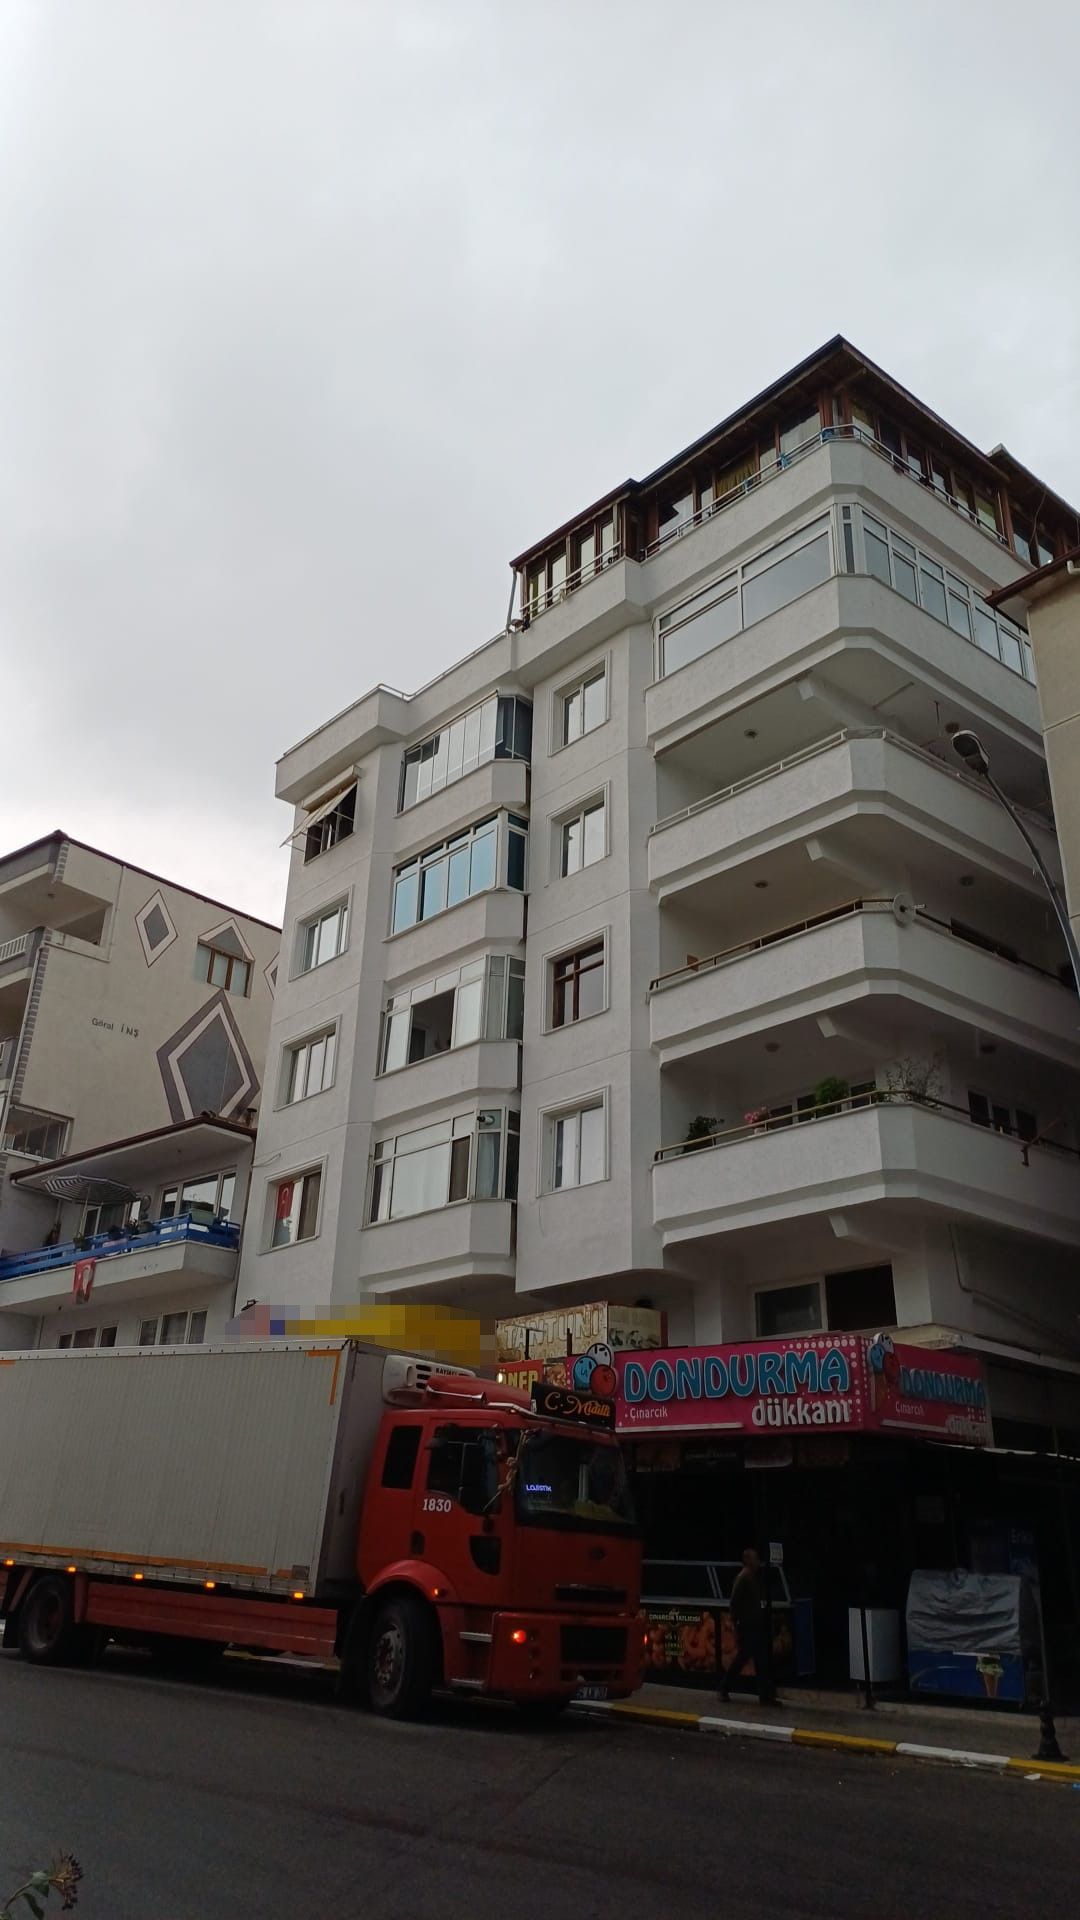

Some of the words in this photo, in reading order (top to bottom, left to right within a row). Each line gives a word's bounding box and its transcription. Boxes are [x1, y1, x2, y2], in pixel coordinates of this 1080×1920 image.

[498, 1369, 539, 1393] ÖNER
[624, 1348, 850, 1403] DONDURMA
[900, 1366, 986, 1408] DONDURMA
[629, 1406, 668, 1422] Çınarcık
[752, 1397, 853, 1427] dükkanı
[423, 1498, 452, 1513] 1830
